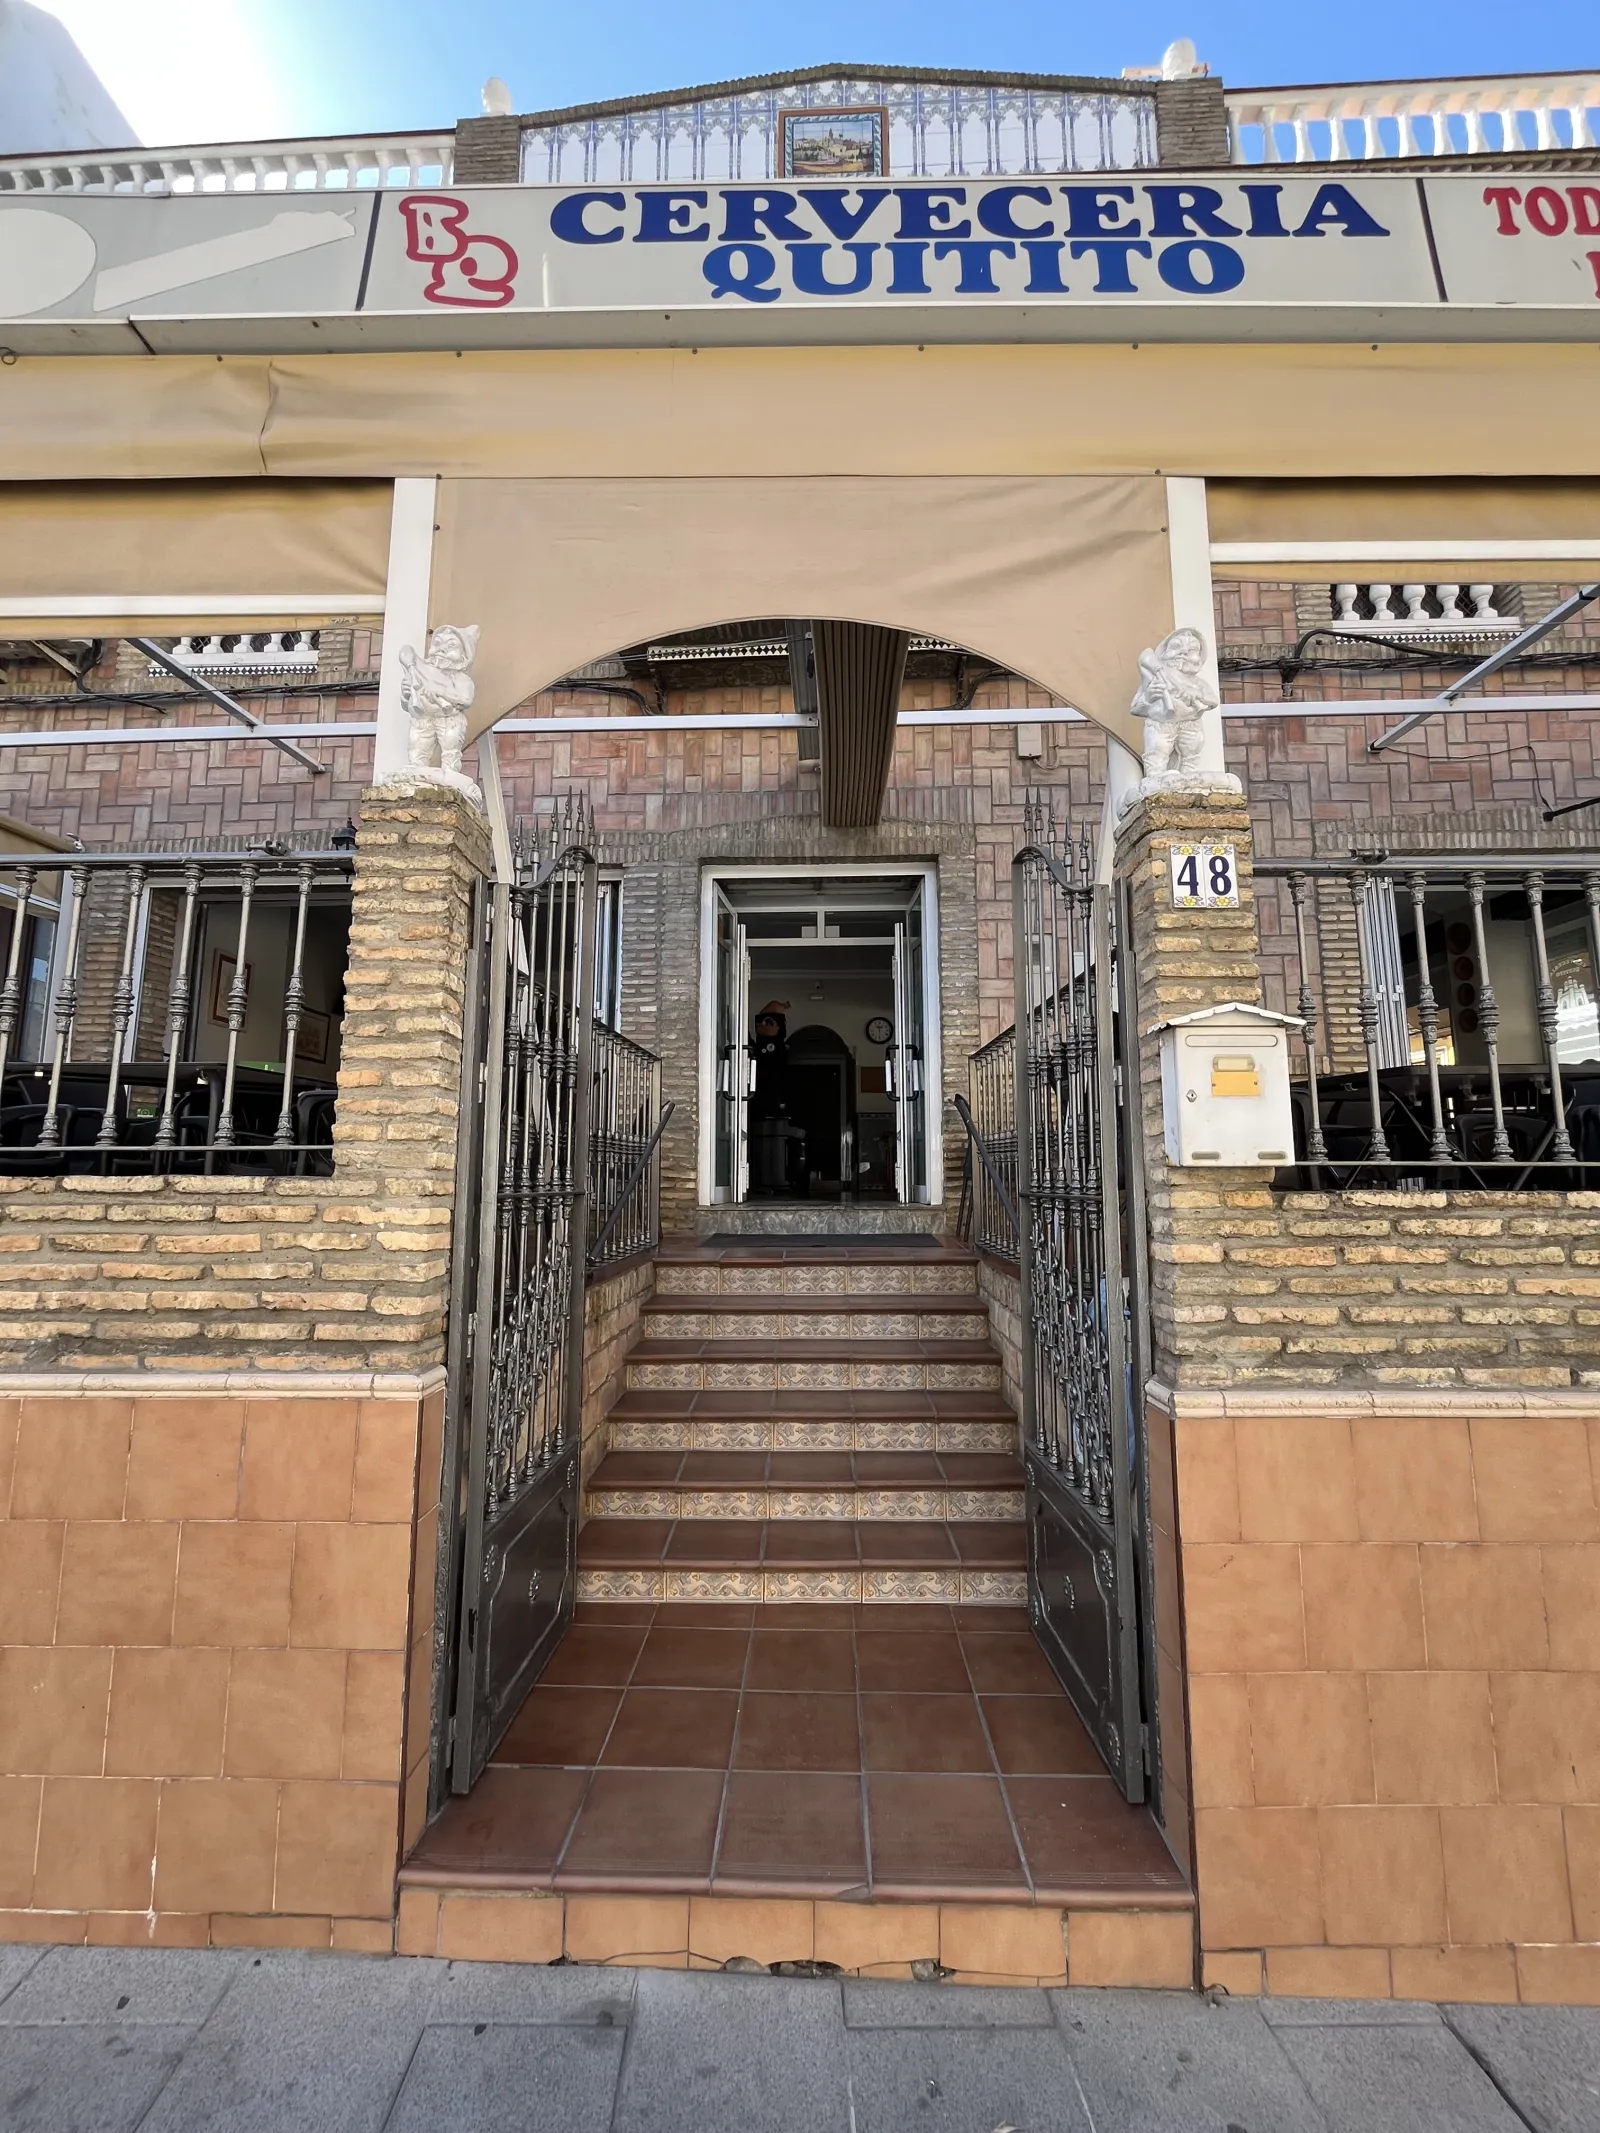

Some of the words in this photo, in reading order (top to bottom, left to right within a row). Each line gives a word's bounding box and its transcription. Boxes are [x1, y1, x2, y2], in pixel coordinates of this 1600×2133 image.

[551, 184, 1389, 244] CERVECERIA
[702, 239, 1245, 303] QUITITO
[1177, 855, 1232, 897] 48
